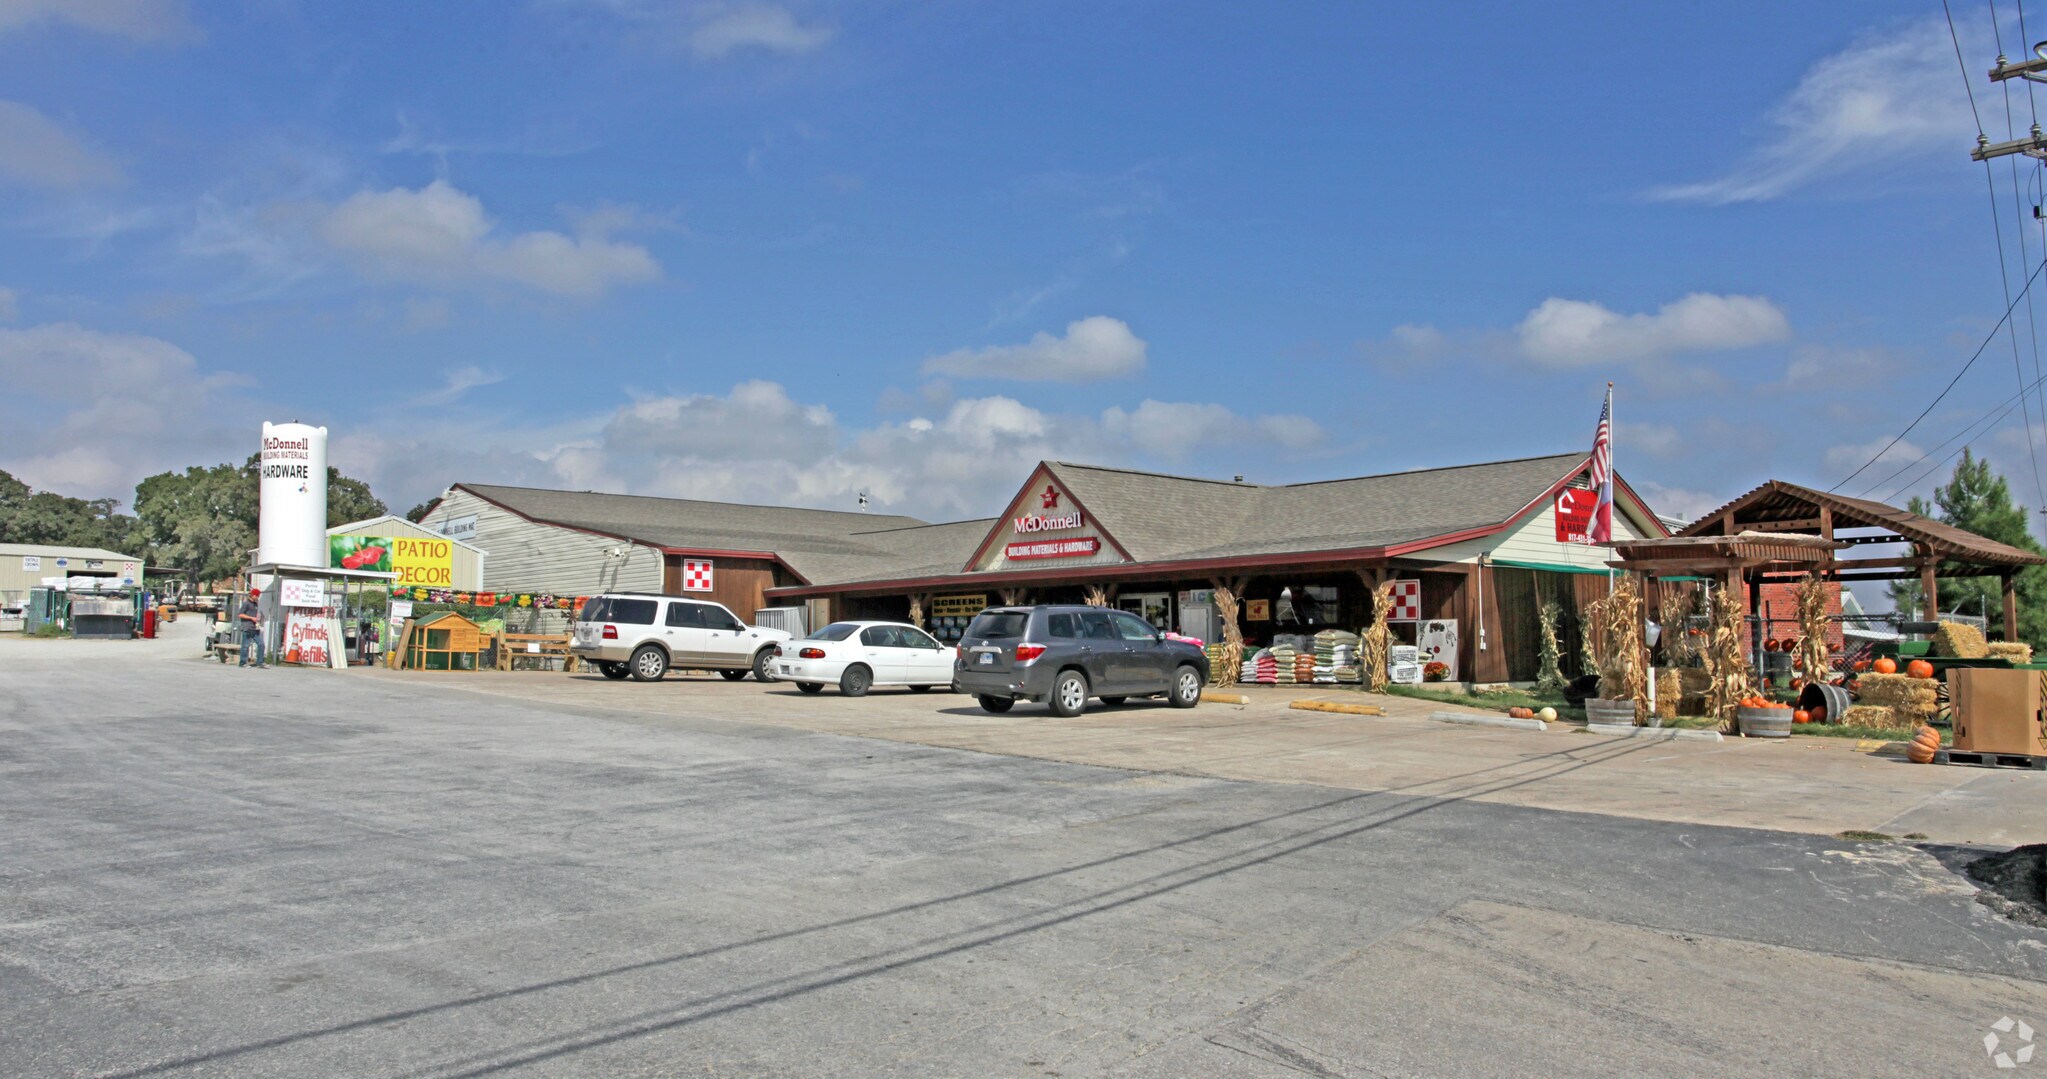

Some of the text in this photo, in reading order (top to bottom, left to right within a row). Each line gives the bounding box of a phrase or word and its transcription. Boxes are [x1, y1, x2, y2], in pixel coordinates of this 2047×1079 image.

[263, 437, 308, 450] McDonnell
[263, 451, 308, 460] BUILDING MATERIALS
[263, 465, 308, 479] HARDWARE
[1014, 512, 1082, 533] McDonnell
[398, 540, 448, 558] PATIO
[1008, 540, 1093, 557] BUILDING MATERIALS & HARDWARE
[393, 566, 451, 584] DECOR
[933, 598, 983, 606] SCREENS
[298, 645, 328, 663] Refills
